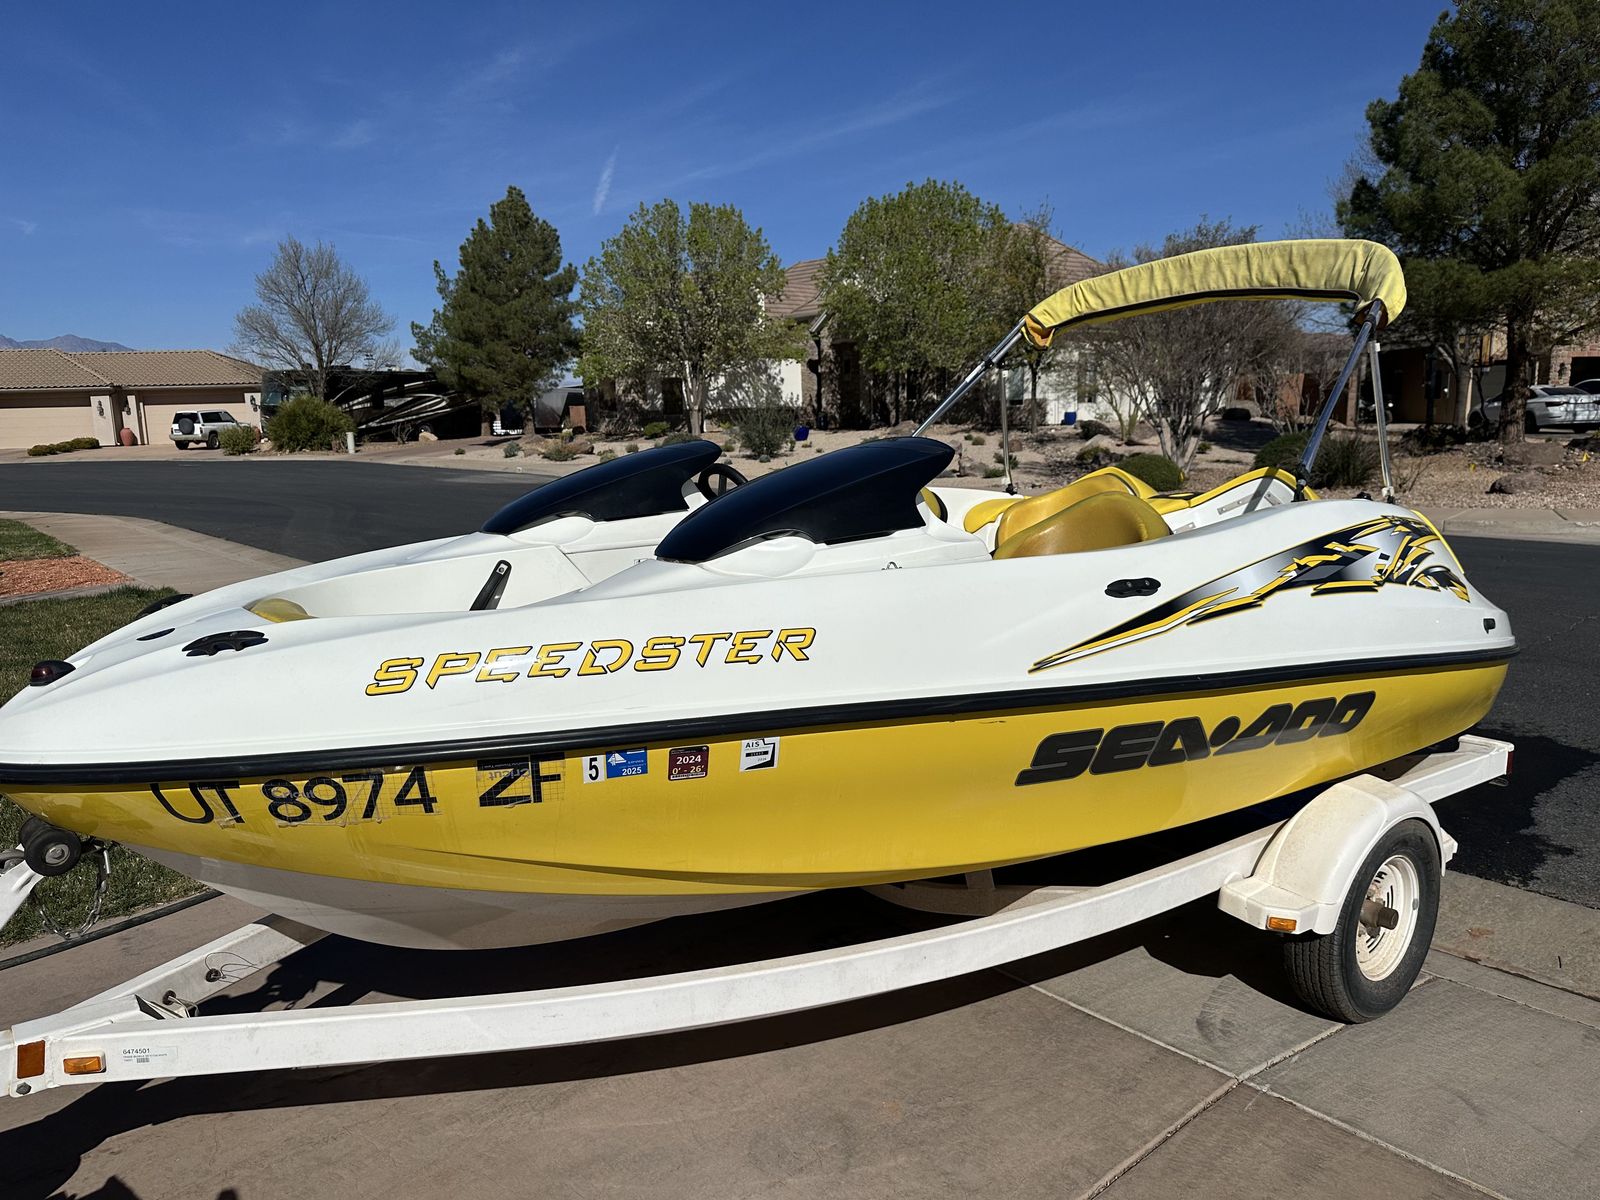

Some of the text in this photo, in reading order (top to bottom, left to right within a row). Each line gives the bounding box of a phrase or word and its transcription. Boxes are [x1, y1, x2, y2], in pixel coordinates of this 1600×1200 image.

[365, 627, 816, 696] SPEEDSTER
[588, 757, 599, 780] 5
[622, 766, 642, 776] 2025
[676, 755, 702, 765] 2024
[150, 752, 564, 824] UT 8974 ZF
